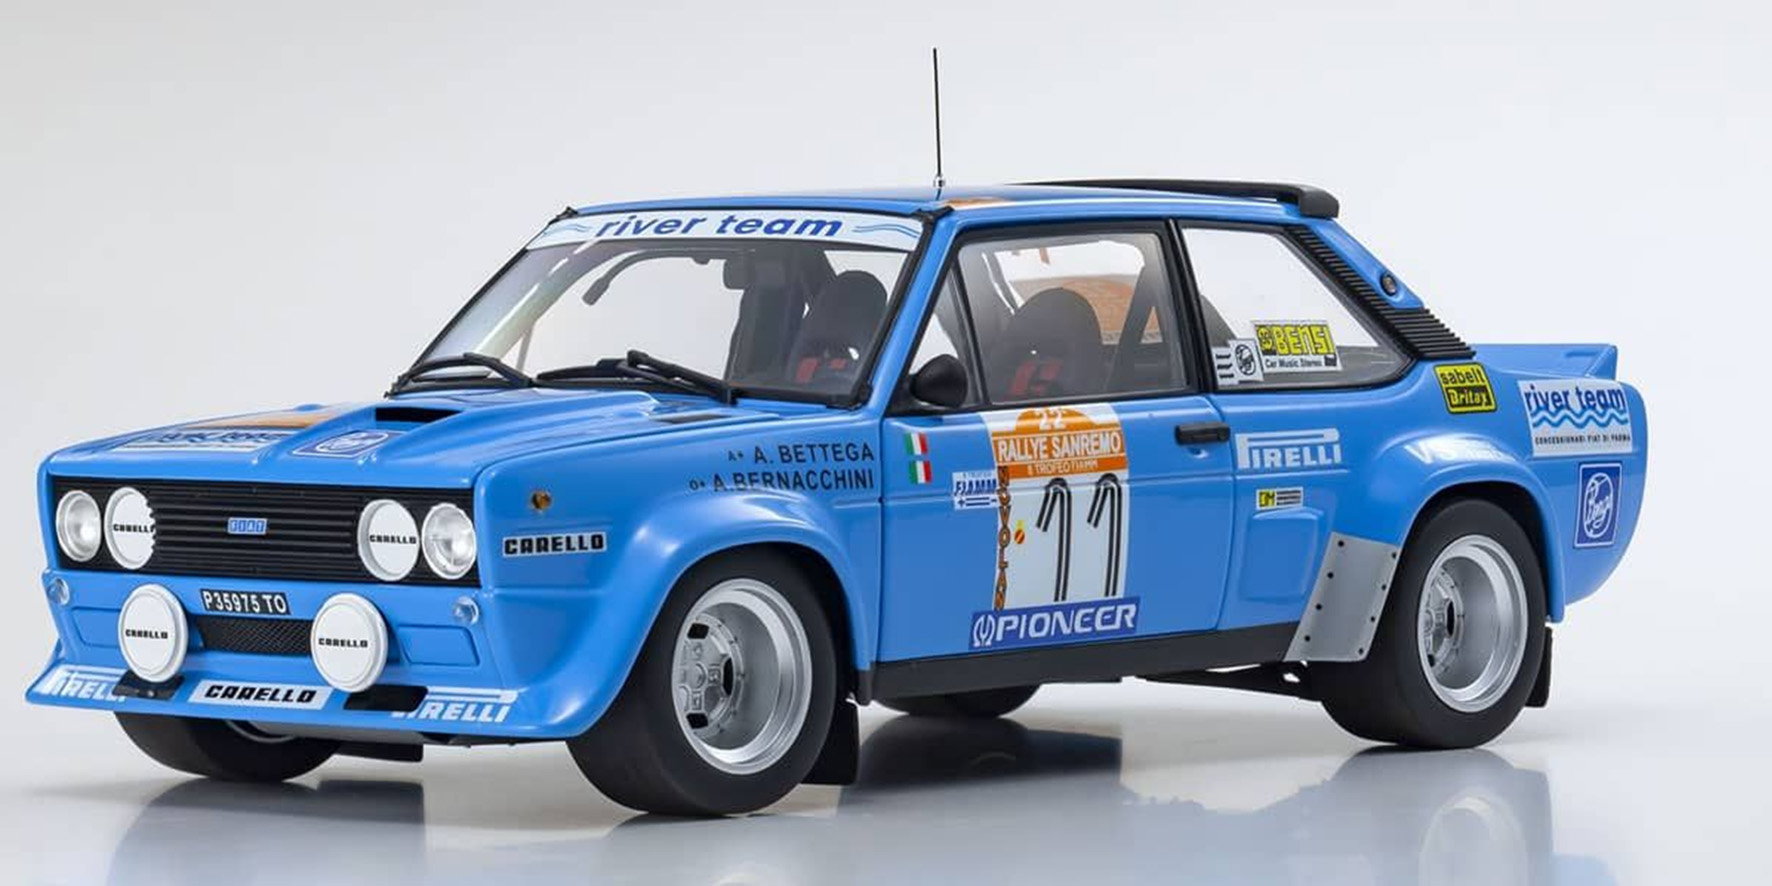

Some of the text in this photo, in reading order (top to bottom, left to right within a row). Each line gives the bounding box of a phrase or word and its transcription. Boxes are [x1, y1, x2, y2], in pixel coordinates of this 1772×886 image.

[596, 214, 844, 238] river team
[1524, 383, 1627, 411] river team
[754, 446, 774, 464] A.
[778, 442, 875, 464] BETTEGA
[998, 431, 1122, 462] RALLYE SANREMO
[1235, 428, 1343, 469] PIRELLI
[231, 519, 264, 532] FIAT
[1036, 472, 1123, 602] 11
[369, 533, 417, 545] CARELLO
[503, 533, 604, 555] CARELLO
[202, 590, 287, 614] P35975 TO
[125, 628, 168, 639] CARELLO
[996, 603, 1137, 642] PIONEER
[318, 637, 368, 648] CARELLO
[204, 684, 317, 704] CARELLO
